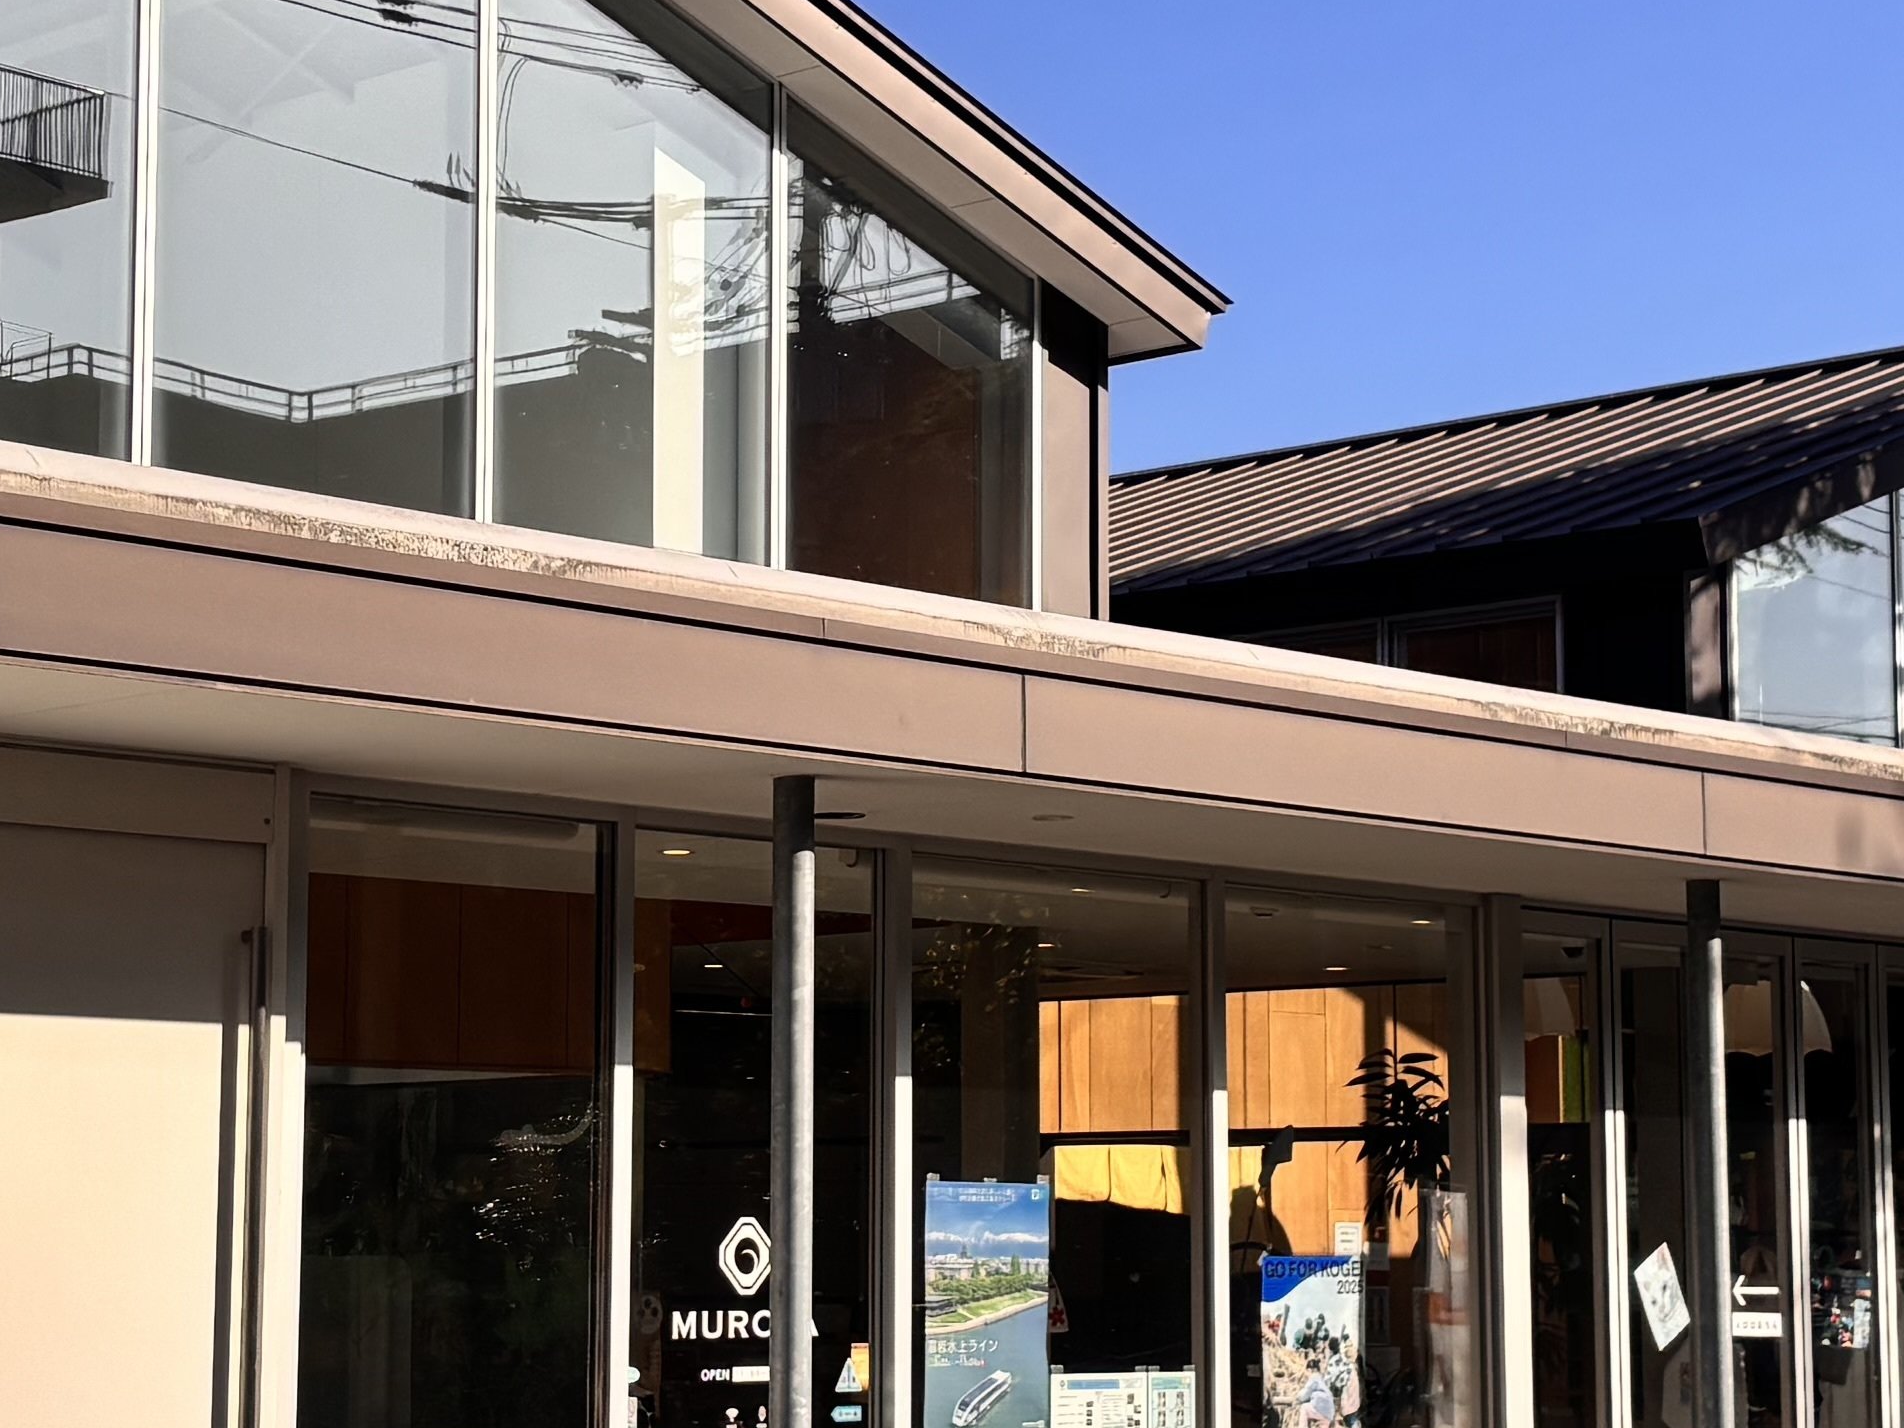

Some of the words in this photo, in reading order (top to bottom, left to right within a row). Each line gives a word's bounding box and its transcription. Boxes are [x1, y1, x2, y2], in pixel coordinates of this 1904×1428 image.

[1264, 1260, 1286, 1278] GO
[1289, 1260, 1318, 1278] FOR
[1321, 1260, 1364, 1277] KOGEI
[1336, 1280, 1365, 1295] 2025
[671, 1309, 819, 1340] MURO
[700, 1368, 730, 1383] OPEN
